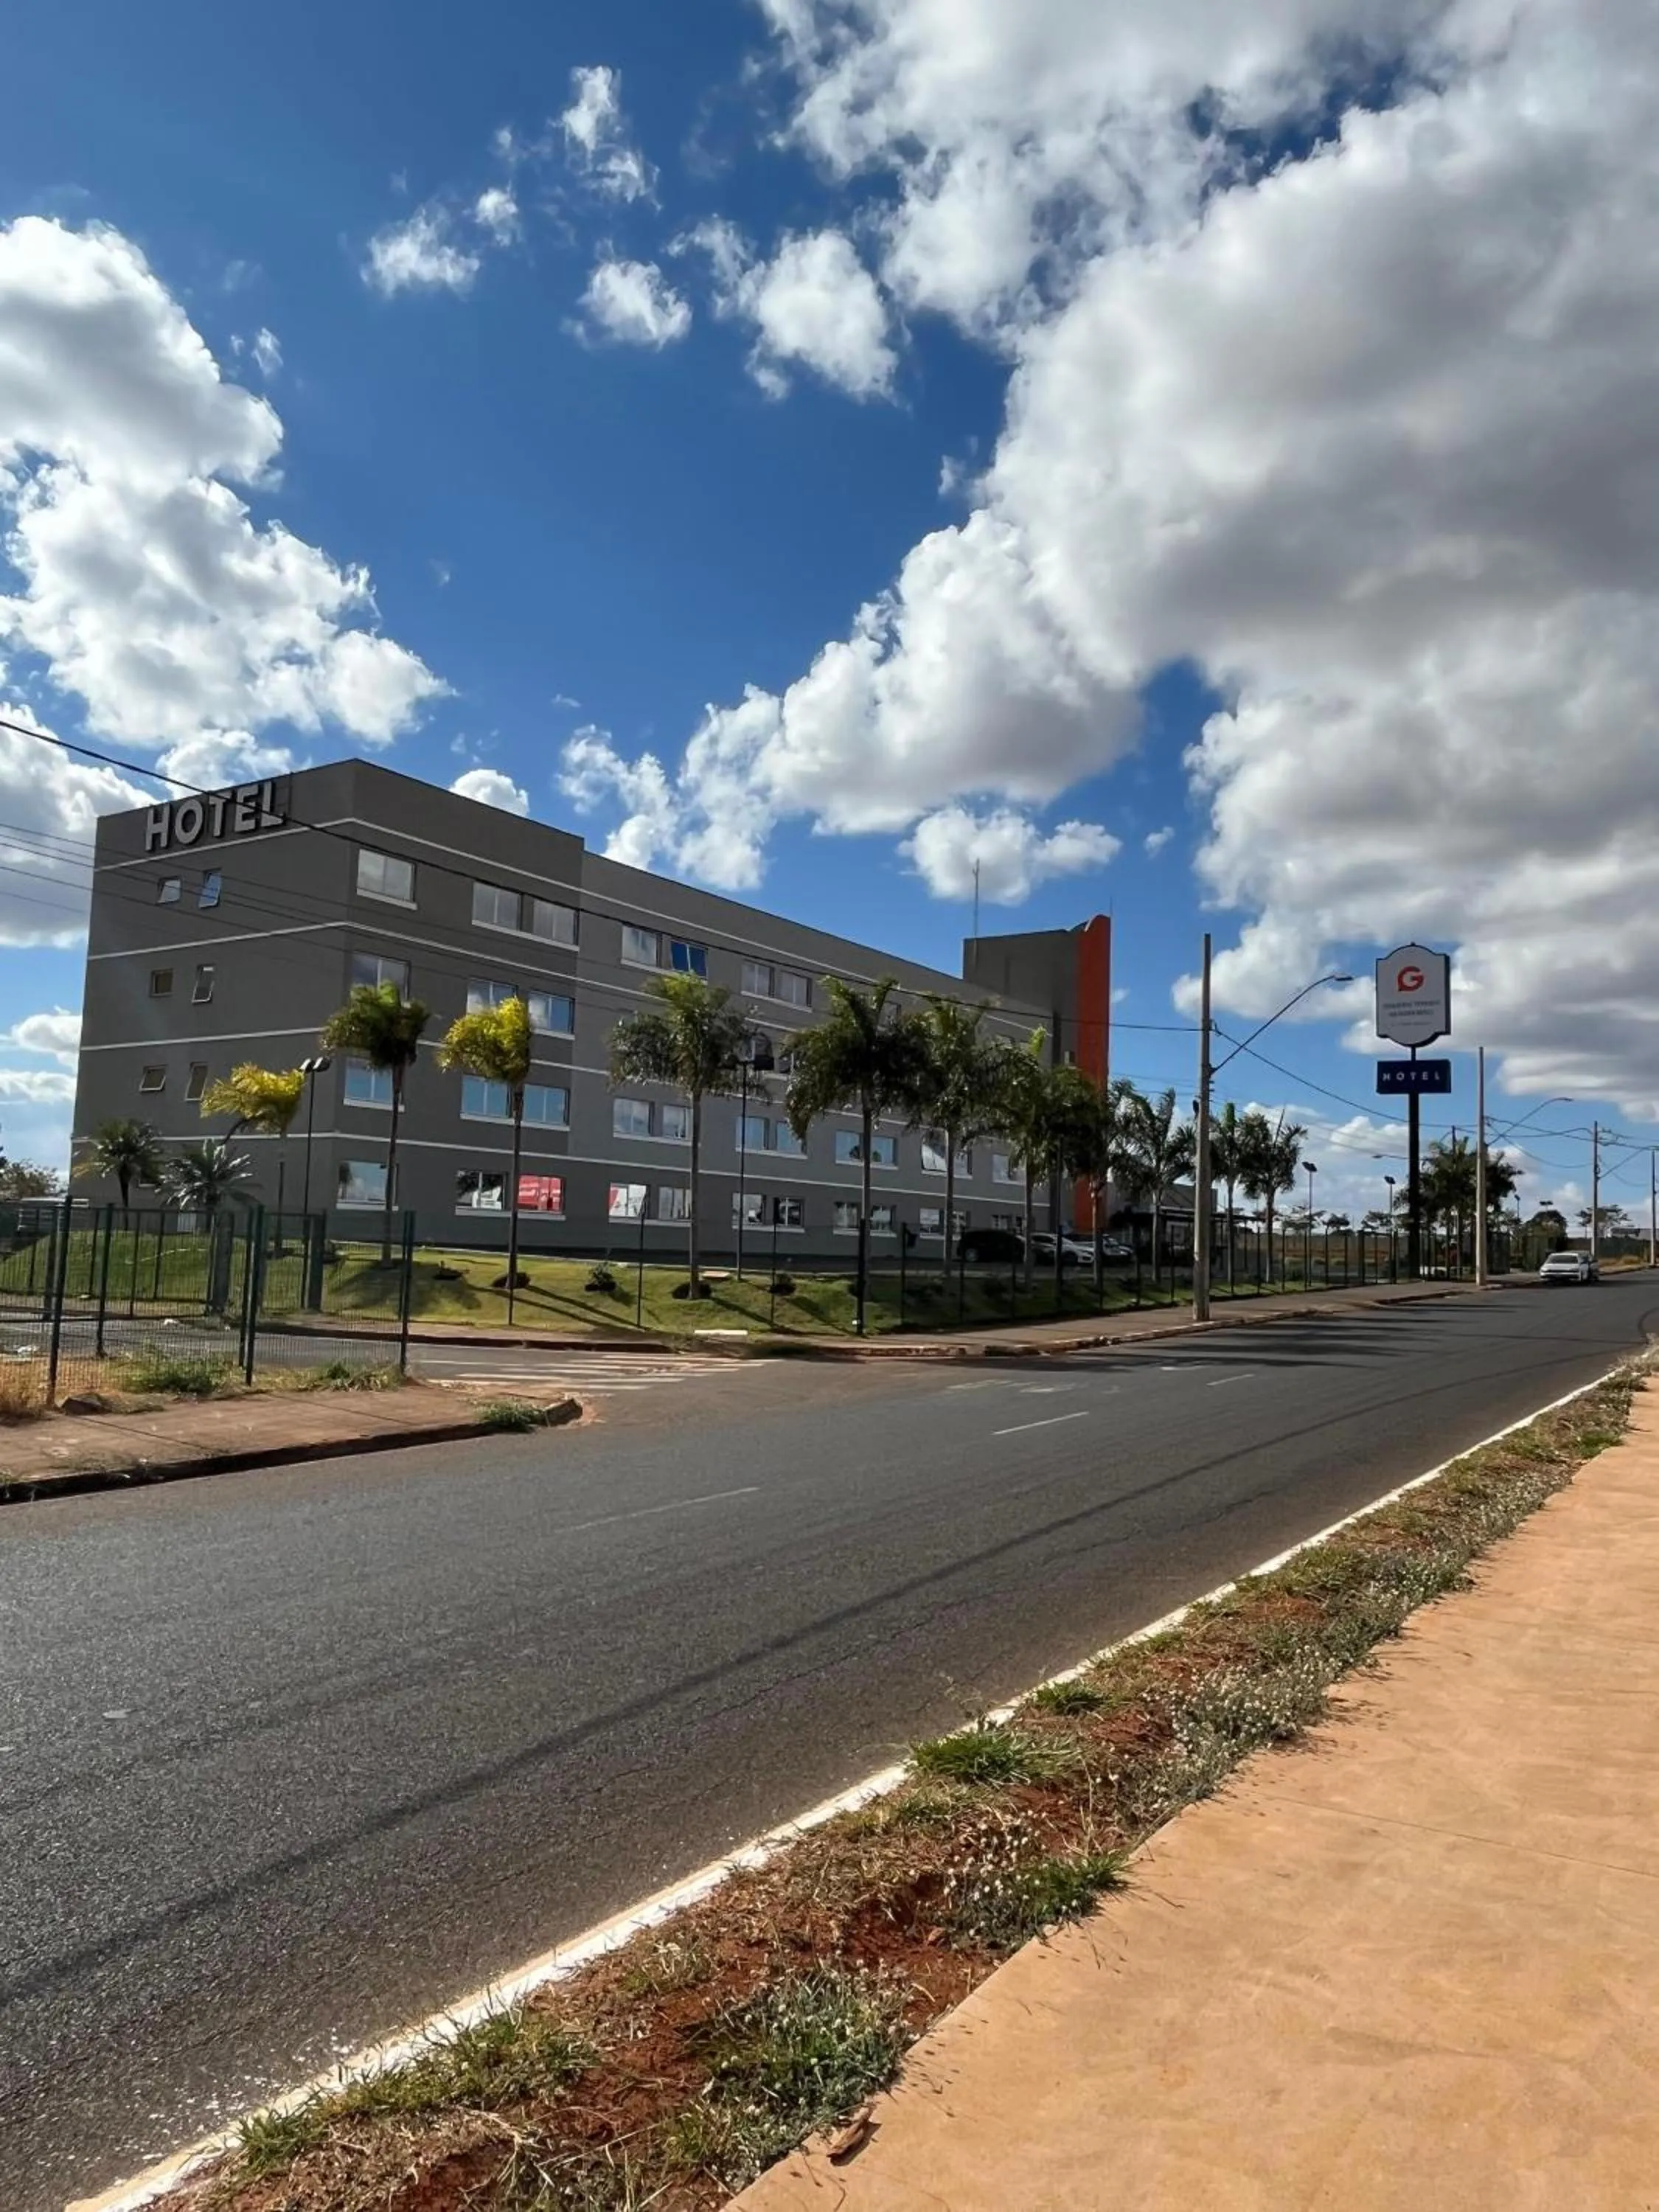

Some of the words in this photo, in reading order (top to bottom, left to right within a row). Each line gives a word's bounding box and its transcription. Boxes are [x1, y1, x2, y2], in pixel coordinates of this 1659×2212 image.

[145, 782, 284, 851] HOTEL
[1397, 966, 1425, 992] G
[1382, 1071, 1440, 1082] HOTEL
